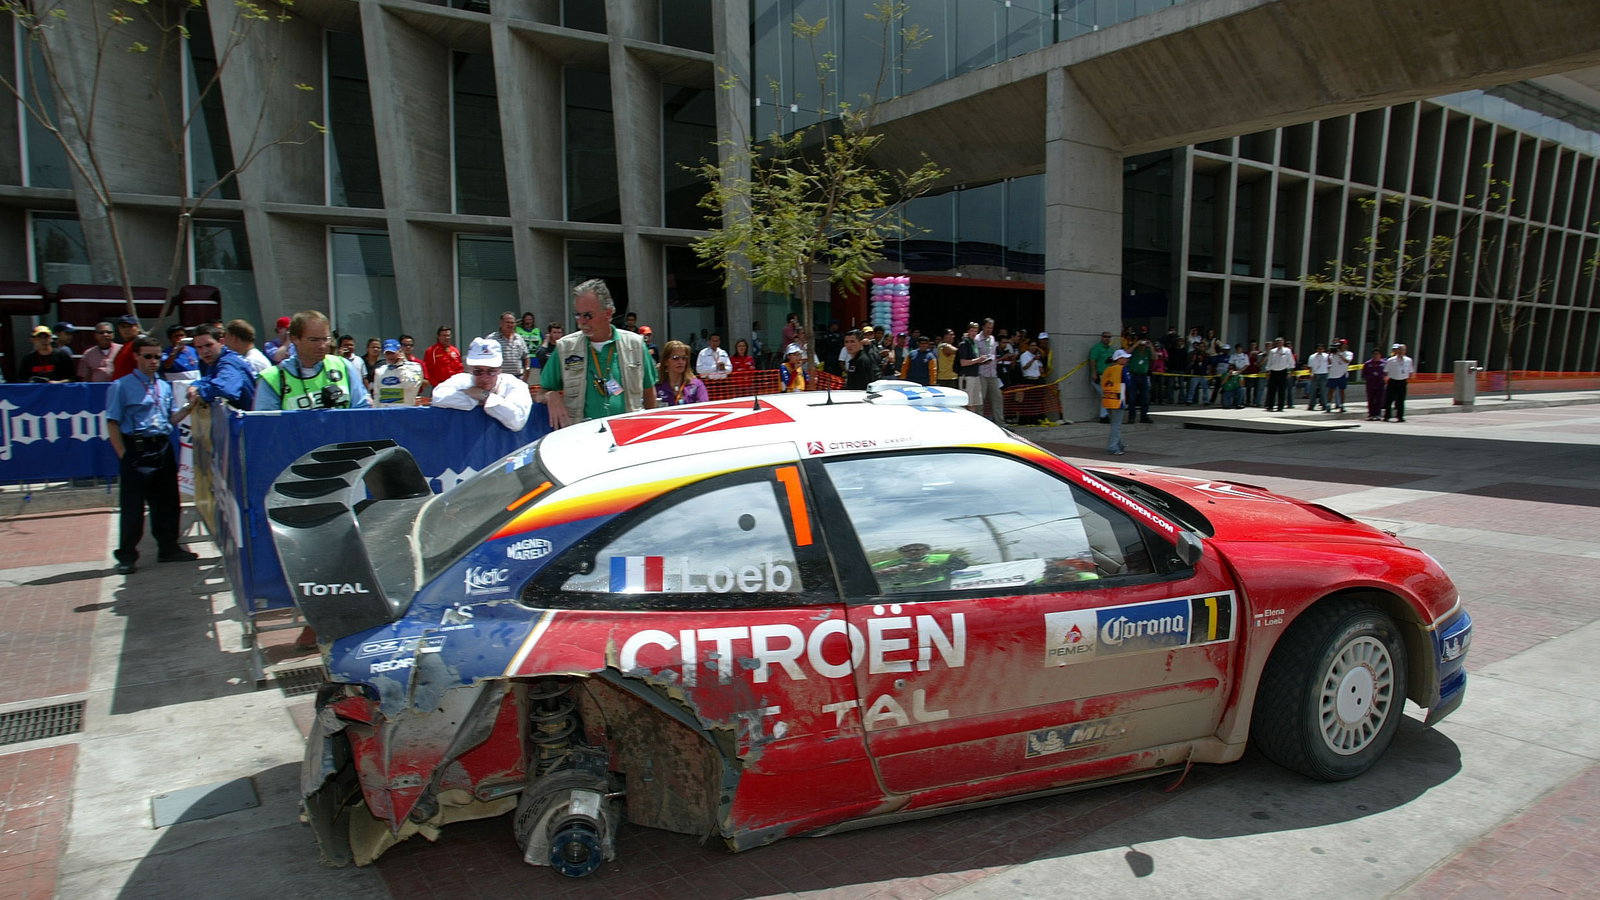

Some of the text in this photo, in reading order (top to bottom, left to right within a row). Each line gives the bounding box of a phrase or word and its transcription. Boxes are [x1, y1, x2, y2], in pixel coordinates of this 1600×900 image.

[775, 465, 813, 546] 1
[298, 582, 370, 596] TOTAL
[679, 555, 793, 593] Loeb
[1101, 614, 1184, 646] Corona
[1205, 597, 1218, 640] 1
[619, 604, 965, 688] CITROËN
[1050, 643, 1094, 657] PEMEX
[370, 657, 417, 674] RECAR
[731, 688, 949, 744] TTAL
